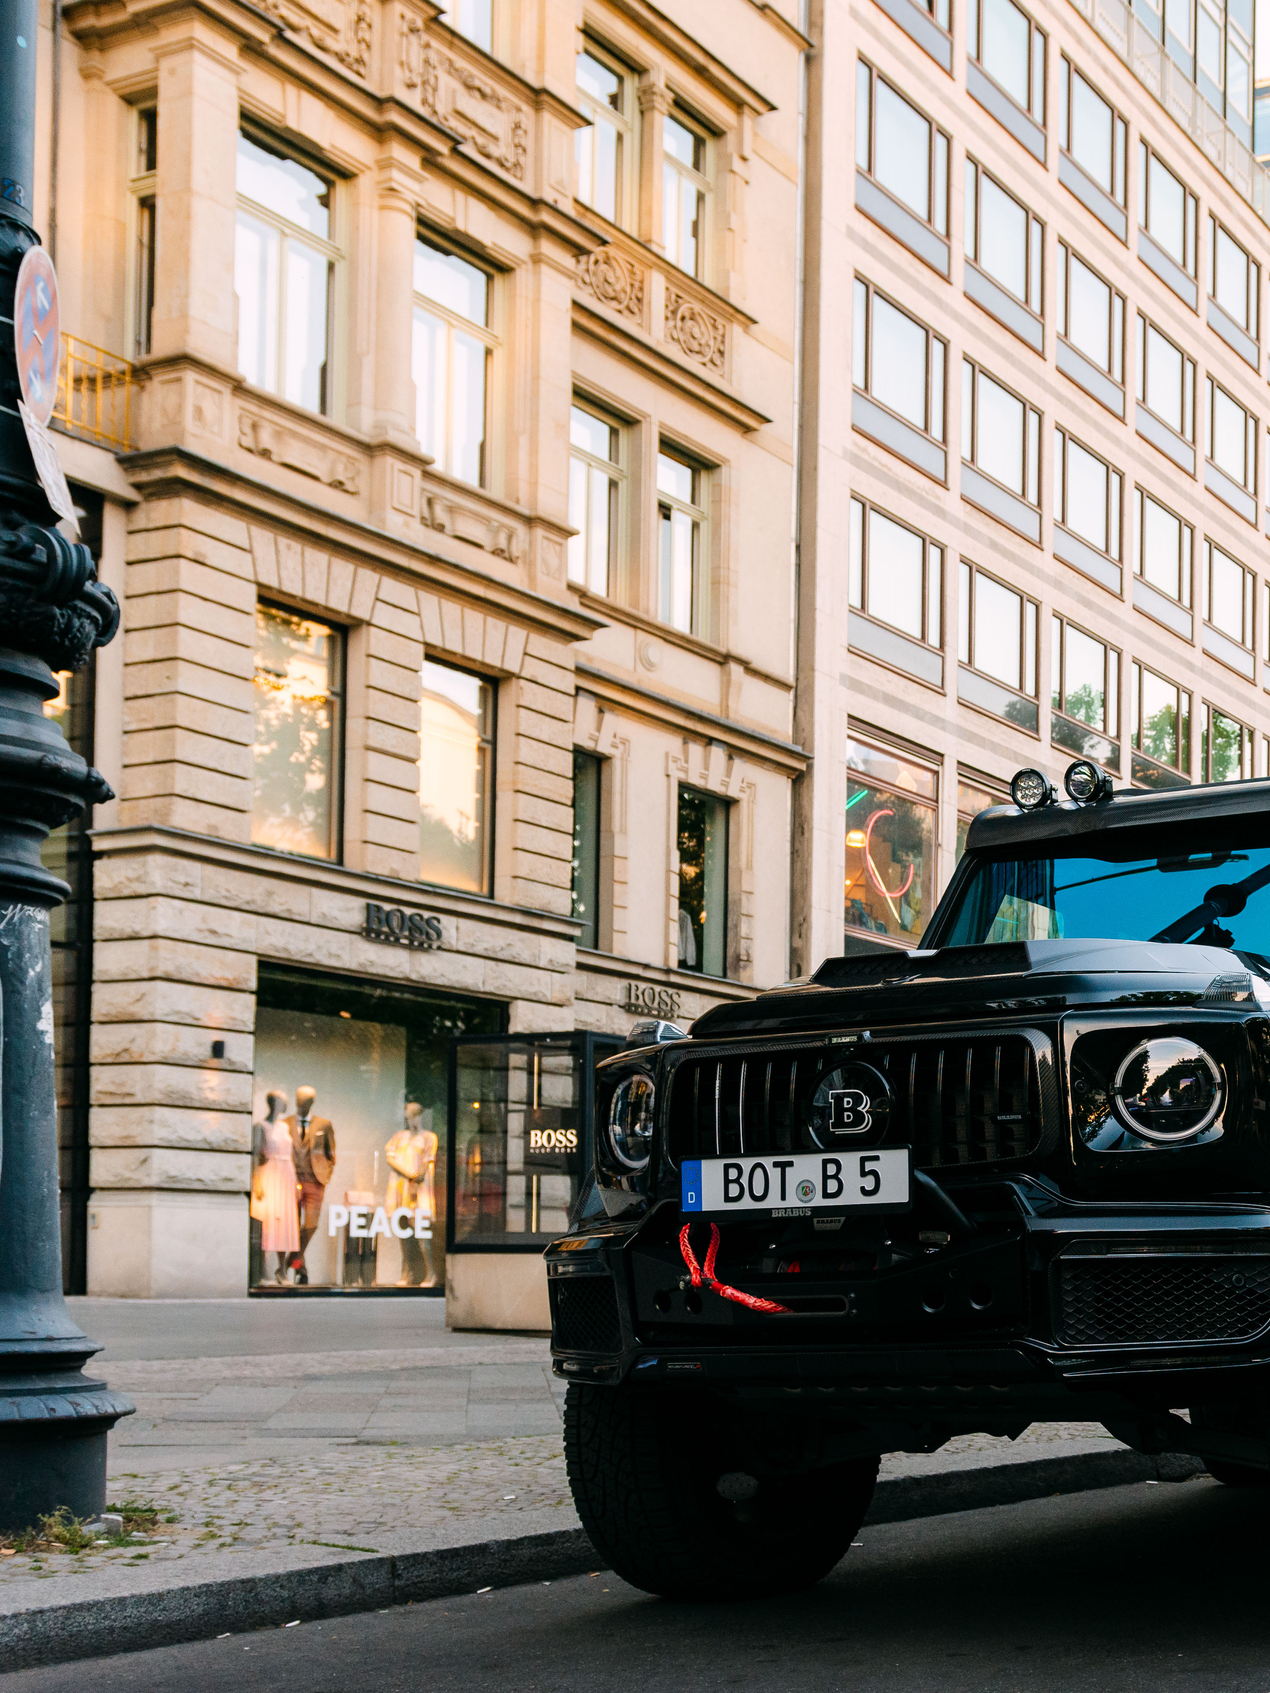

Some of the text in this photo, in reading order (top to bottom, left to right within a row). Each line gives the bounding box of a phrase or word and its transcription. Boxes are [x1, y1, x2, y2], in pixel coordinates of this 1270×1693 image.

[365, 903, 443, 942] BOSS
[627, 982, 681, 1011] BOSS
[829, 1089, 872, 1134] B
[530, 1128, 578, 1147] BOSS
[723, 1154, 881, 1204] BOT B 5
[687, 1192, 696, 1204] D
[772, 1208, 813, 1218] BRABUS
[328, 1204, 433, 1239] PEACE
